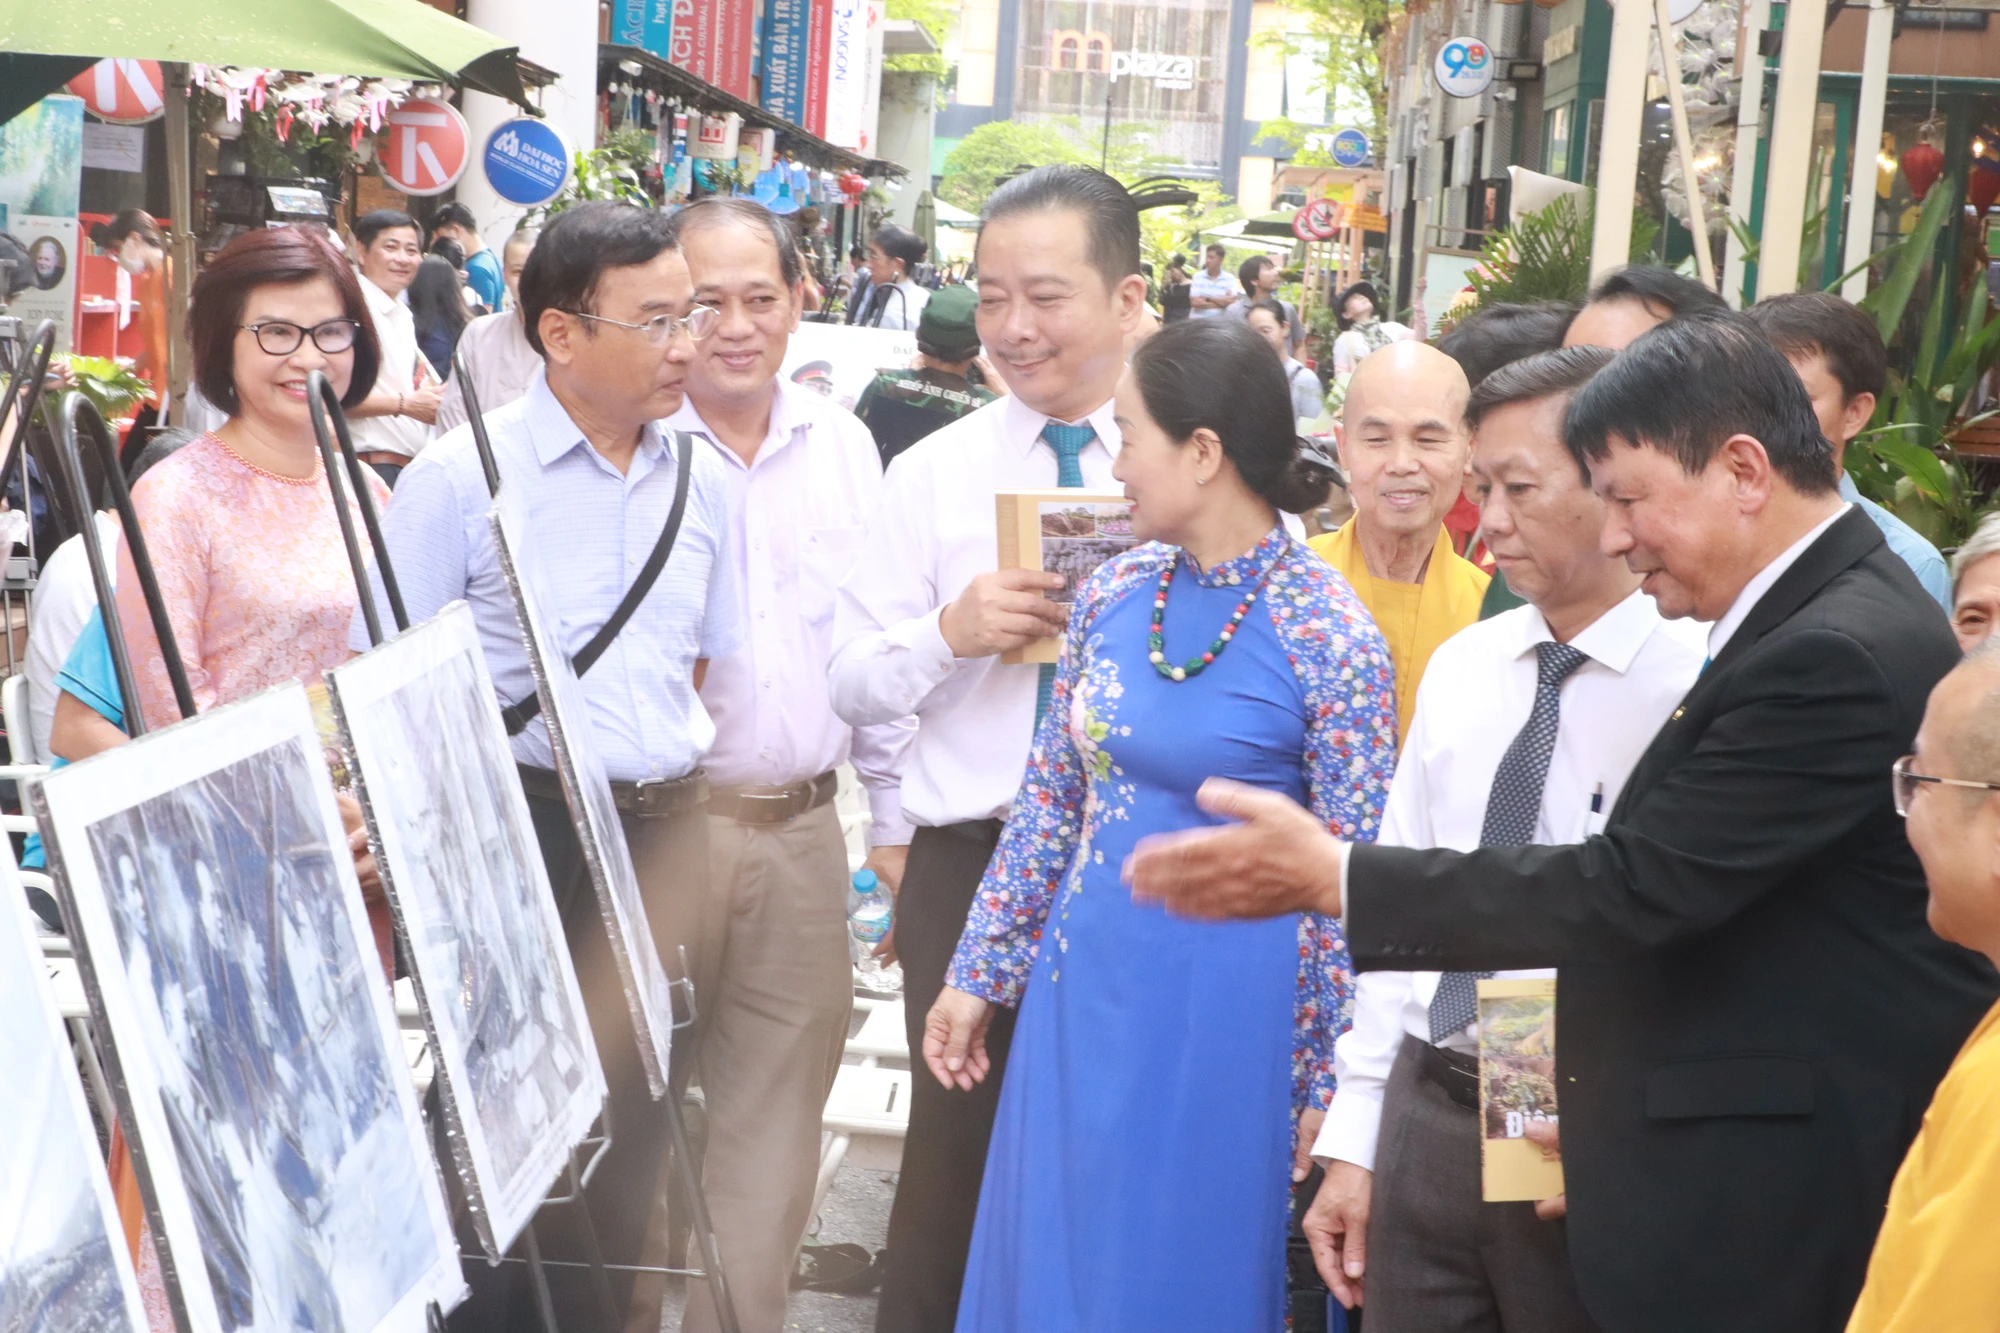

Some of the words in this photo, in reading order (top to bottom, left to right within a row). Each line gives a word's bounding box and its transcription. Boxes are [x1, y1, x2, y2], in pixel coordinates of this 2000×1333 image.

[697, 5, 709, 48] CULTURAL
[773, 0, 792, 20] TR
[791, 0, 802, 28] HOUS
[815, 4, 824, 28] HOUSE
[768, 23, 789, 54] BẢN
[813, 29, 823, 66] PUBLISHING
[835, 20, 850, 81] SAIGON
[766, 58, 788, 94] XUẤT
[787, 36, 801, 104] PUBLISHING
[810, 68, 821, 99] POLITICAL
